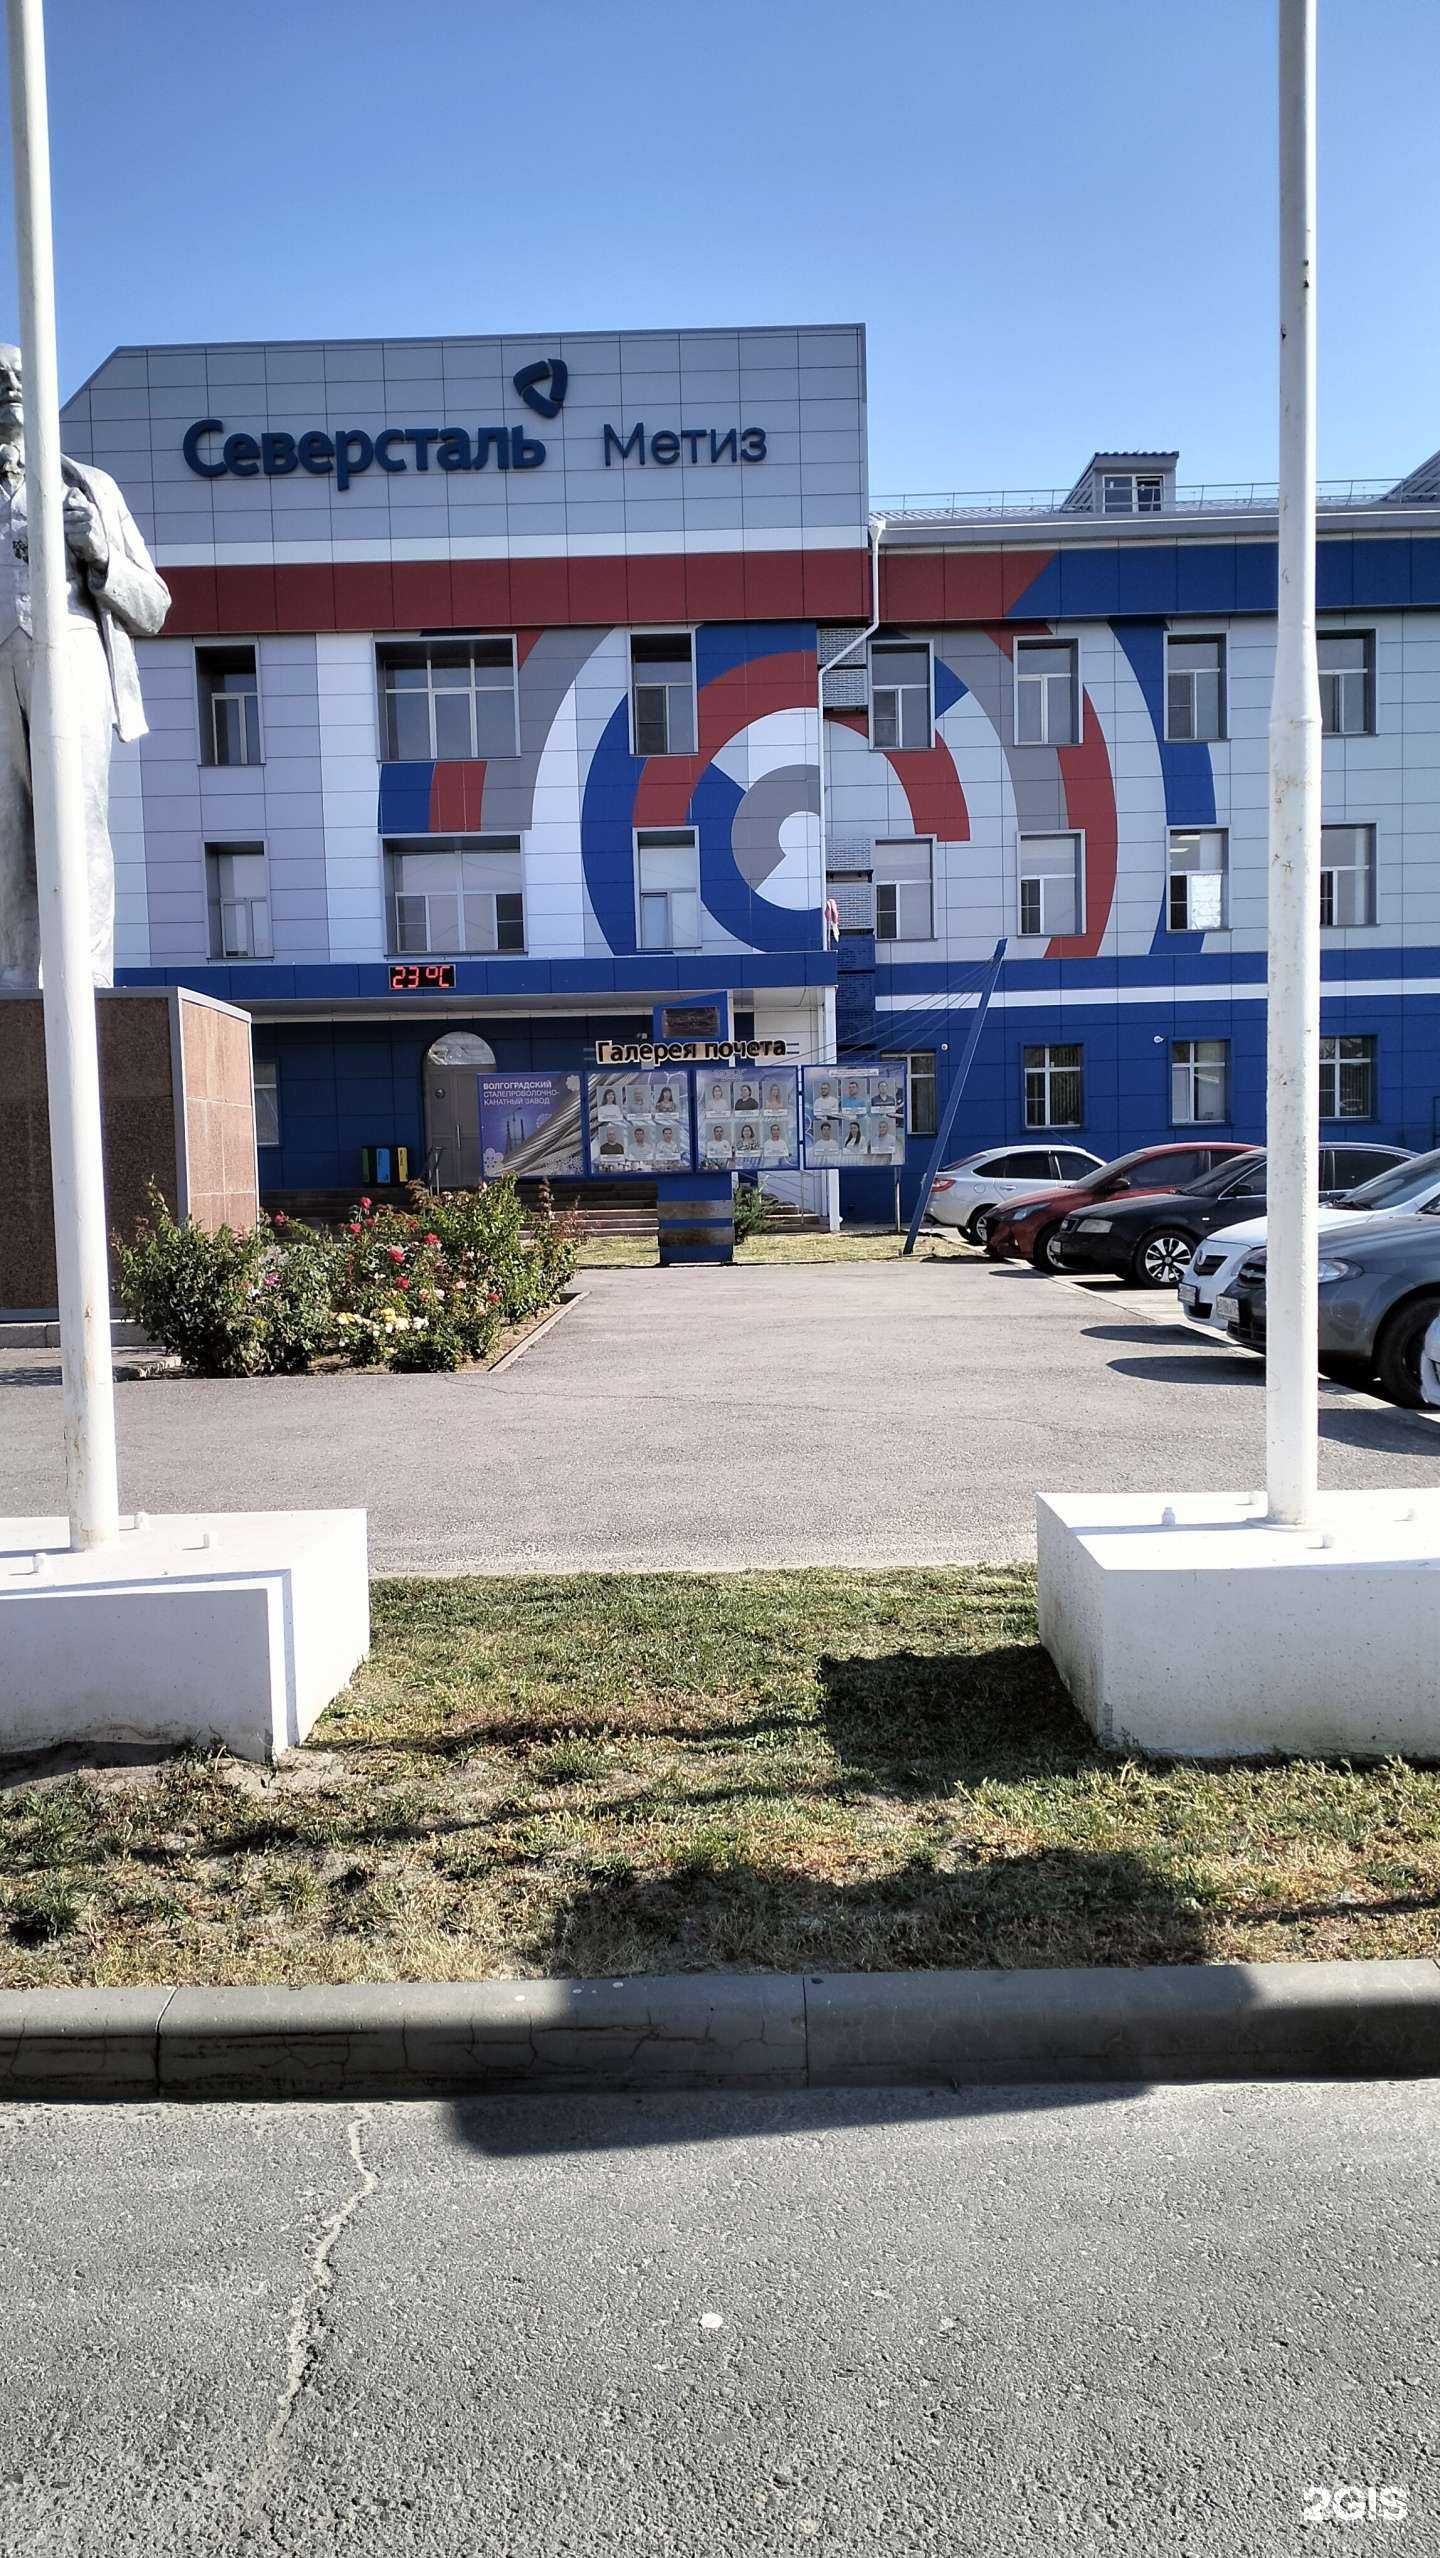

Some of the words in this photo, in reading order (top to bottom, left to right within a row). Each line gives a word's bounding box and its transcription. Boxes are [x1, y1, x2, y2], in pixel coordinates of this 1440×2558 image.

[183, 419, 547, 492] Северсталь
[602, 422, 768, 467] Метиз
[597, 1041, 697, 1064] Галерея
[704, 1039, 787, 1058] почета
[483, 1080, 552, 1090] ВОЛГОГРАДСКИЙ
[483, 1090, 560, 1098] СТАЛЕПРОВОЛОЧНО-
